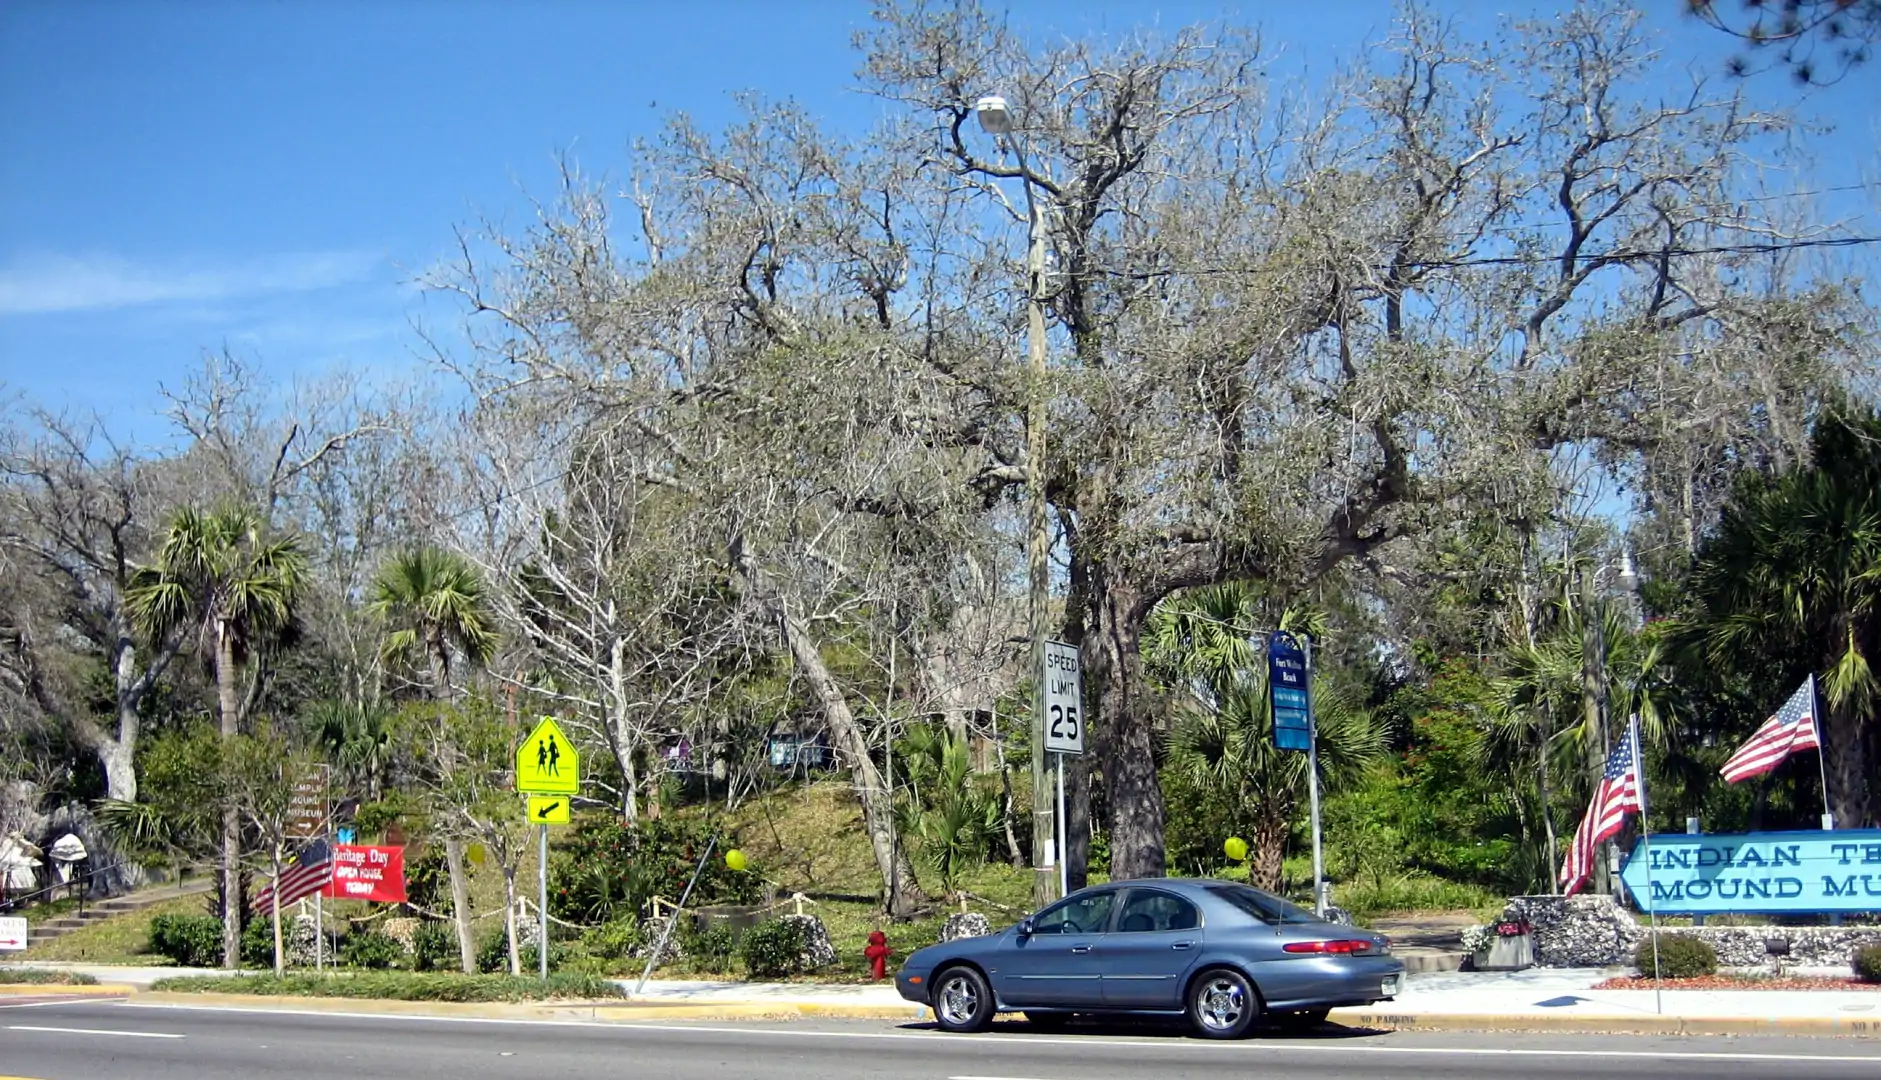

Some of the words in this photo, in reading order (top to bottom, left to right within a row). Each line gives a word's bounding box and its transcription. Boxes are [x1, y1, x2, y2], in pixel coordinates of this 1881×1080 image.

[1048, 654, 1077, 672] SPEED
[1052, 680, 1074, 697] LIMIT
[1051, 705, 1078, 740] 25
[370, 849, 388, 867] Day
[1650, 846, 1801, 869] INDIAN
[337, 866, 358, 878] OPEN
[359, 867, 383, 880] HOUSE
[346, 882, 374, 895] TODAY
[1651, 877, 1803, 901] MOUND
[1821, 875, 1881, 896] MU
[1361, 1015, 1372, 1024] NO
[1376, 1015, 1417, 1024] PARKING
